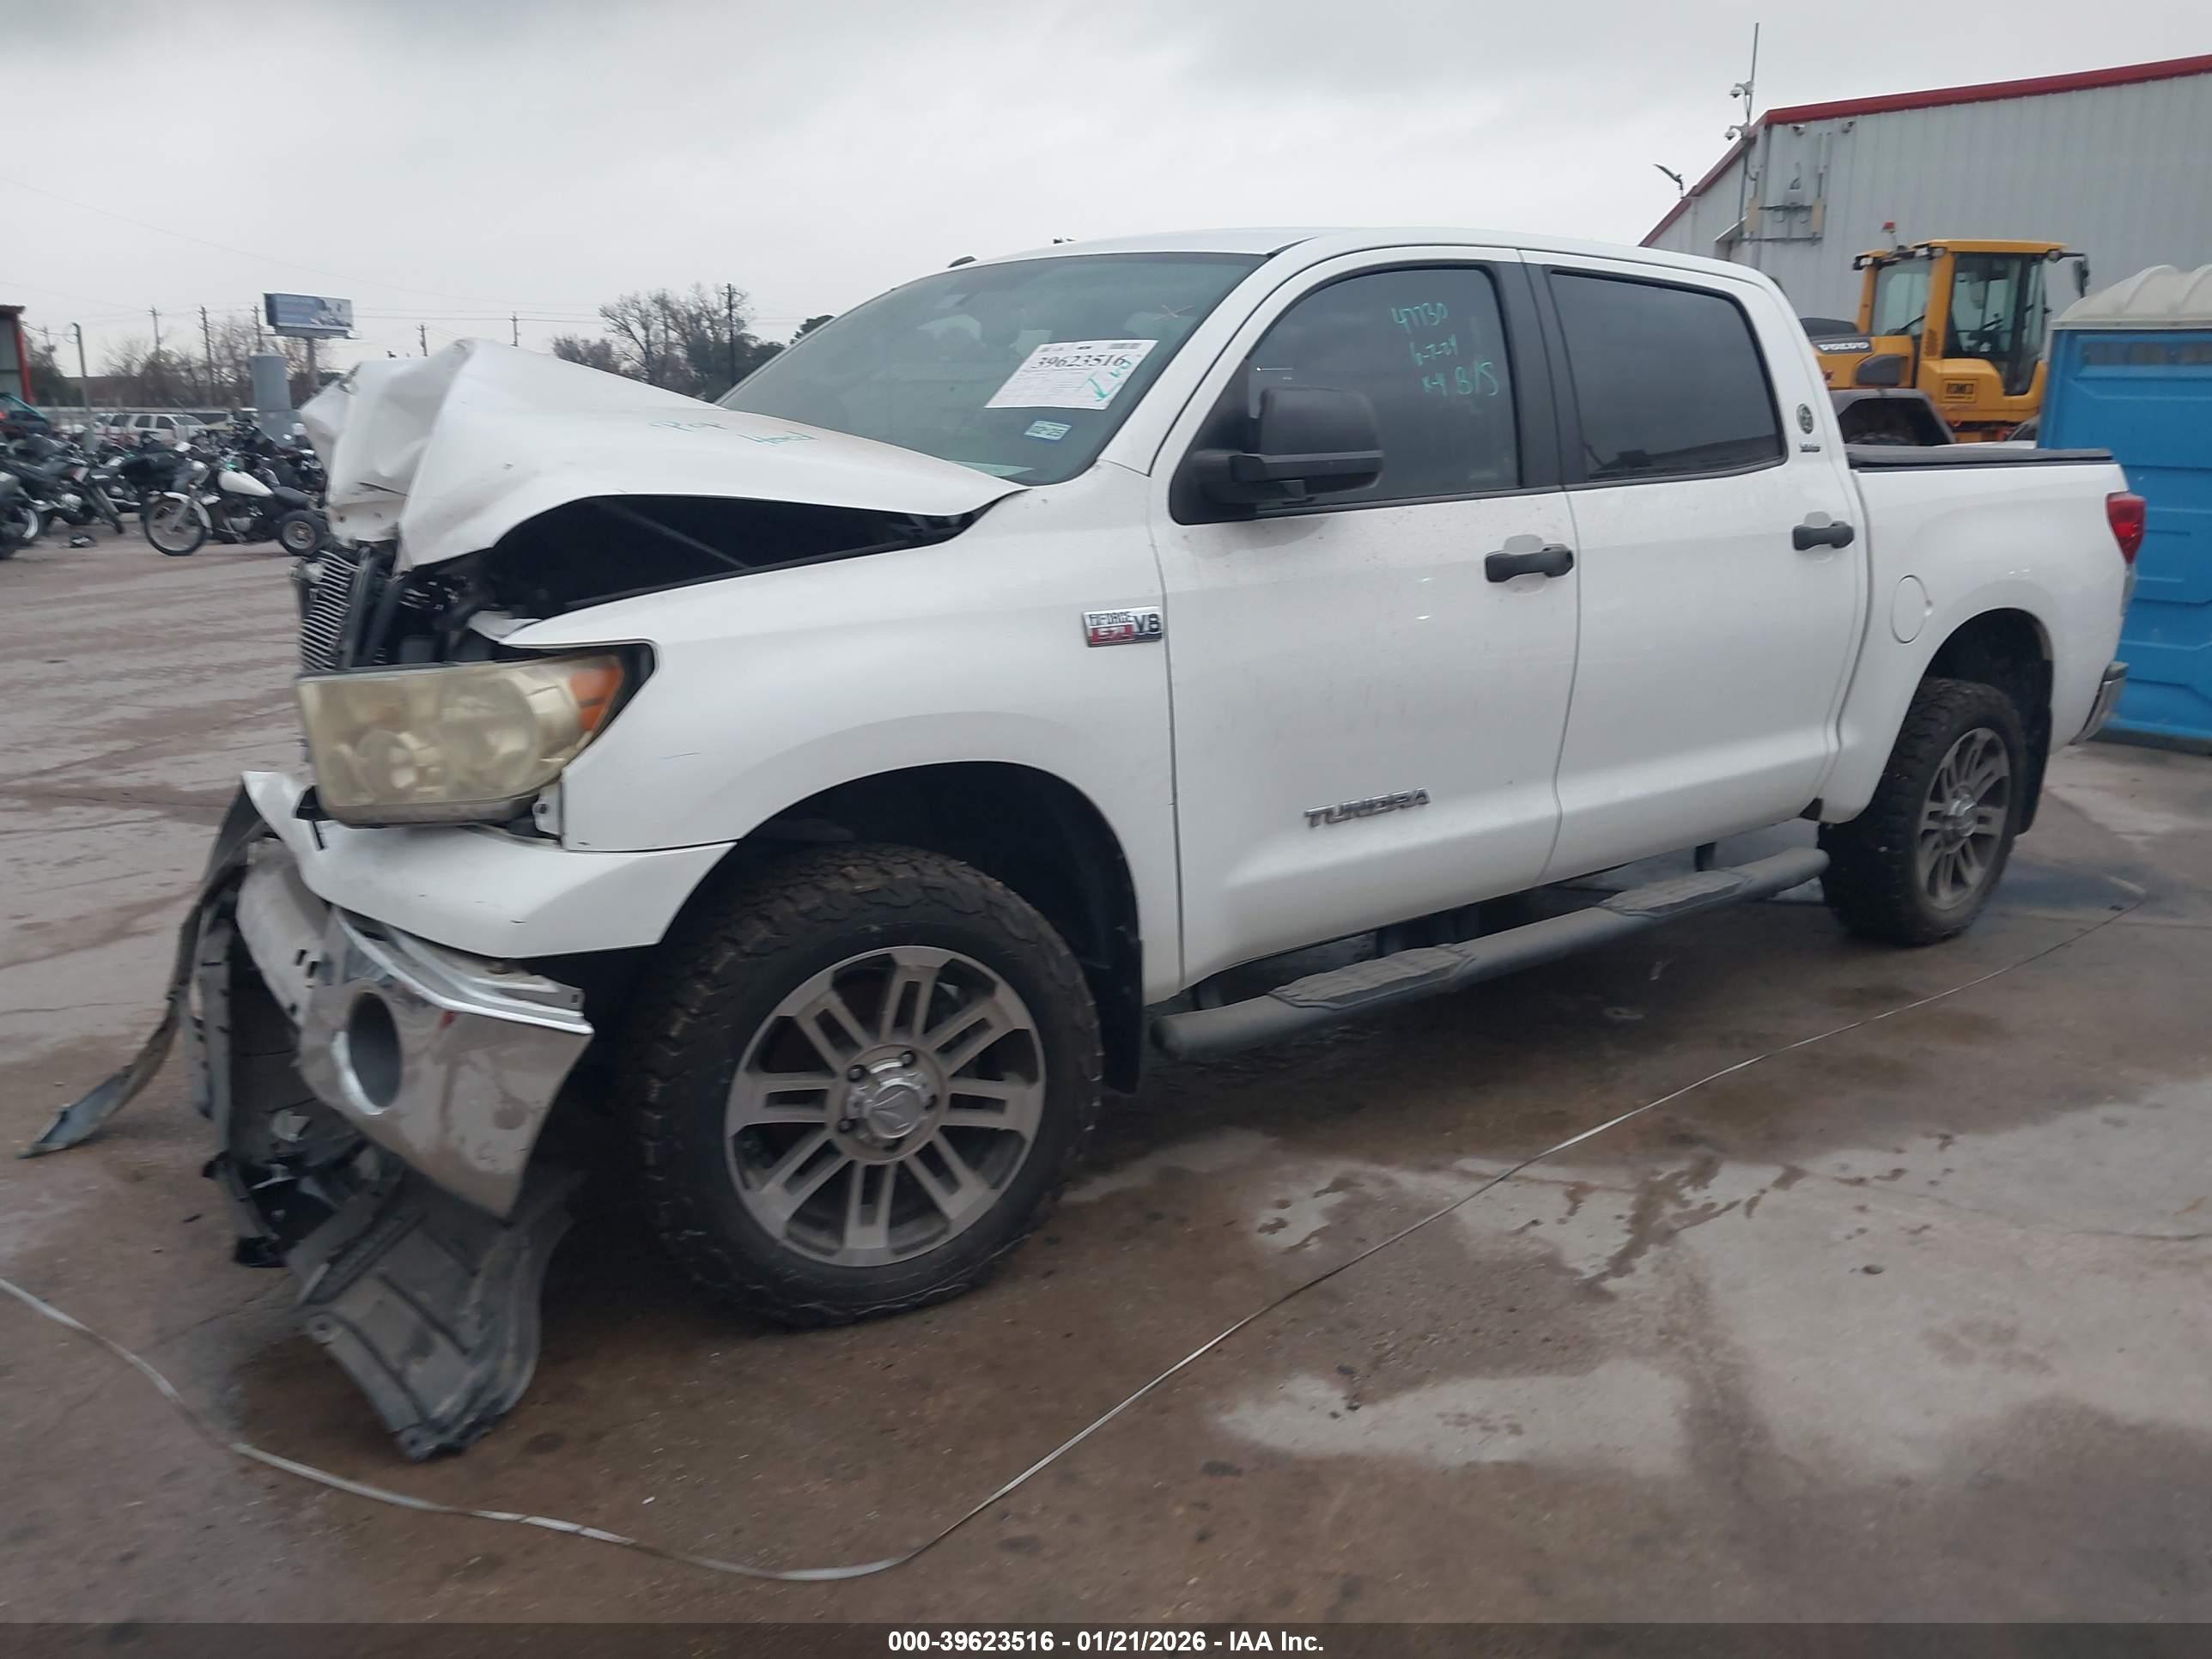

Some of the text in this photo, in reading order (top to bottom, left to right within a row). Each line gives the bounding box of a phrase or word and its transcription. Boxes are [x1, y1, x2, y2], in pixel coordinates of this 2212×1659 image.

[1030, 354, 1129, 369] 39623516
[1133, 612, 1162, 634] V8
[1304, 787, 1431, 828] TUNDRA
